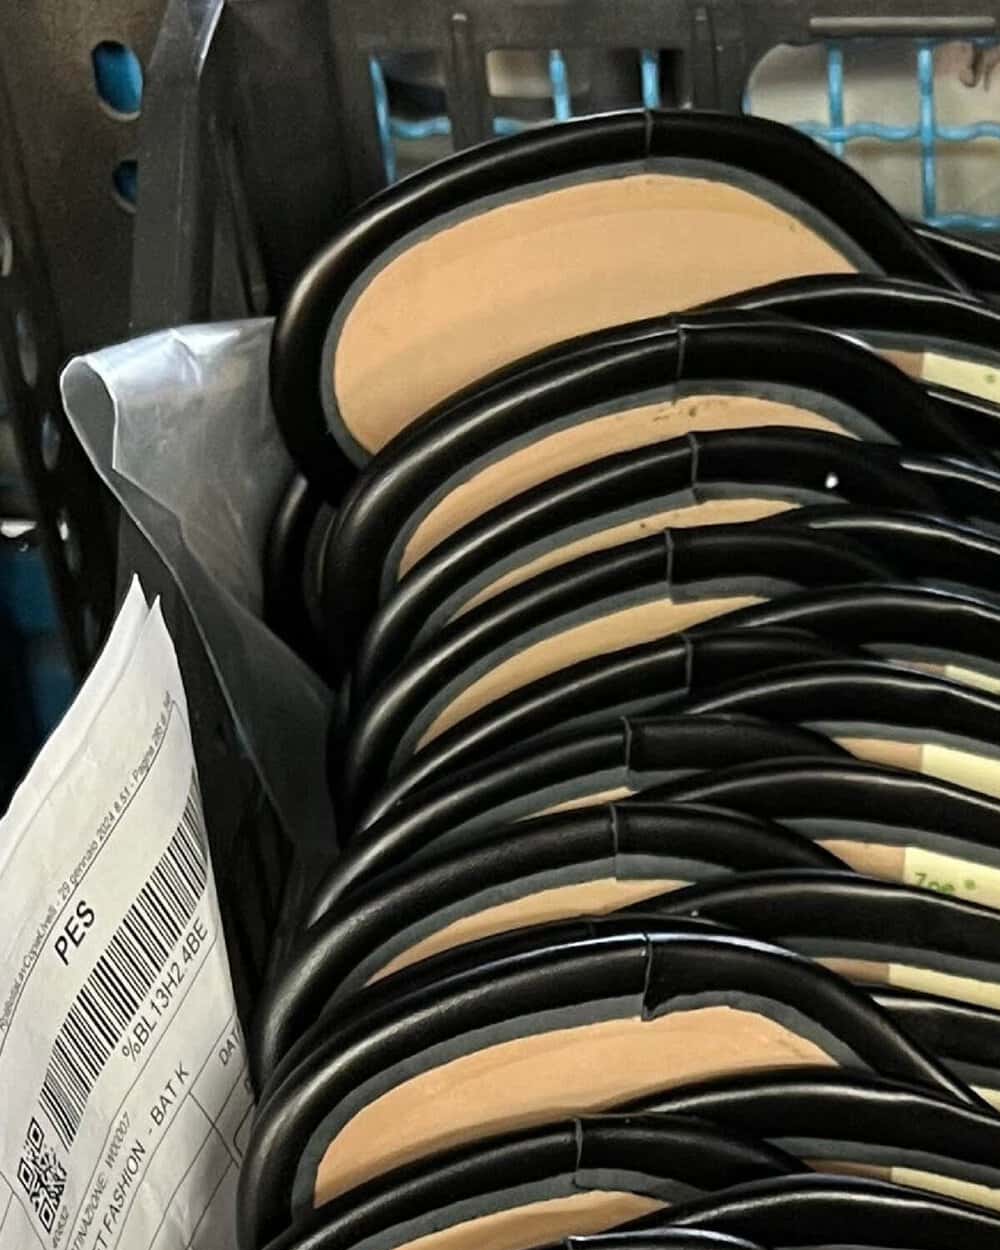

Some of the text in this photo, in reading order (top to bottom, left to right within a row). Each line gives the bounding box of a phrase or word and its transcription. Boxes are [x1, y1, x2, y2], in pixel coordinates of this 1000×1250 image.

[55, 899, 95, 966] PES
[103, 1138, 146, 1235] FASHION
[149, 1078, 178, 1127] BAT
[176, 1061, 190, 1085] K
